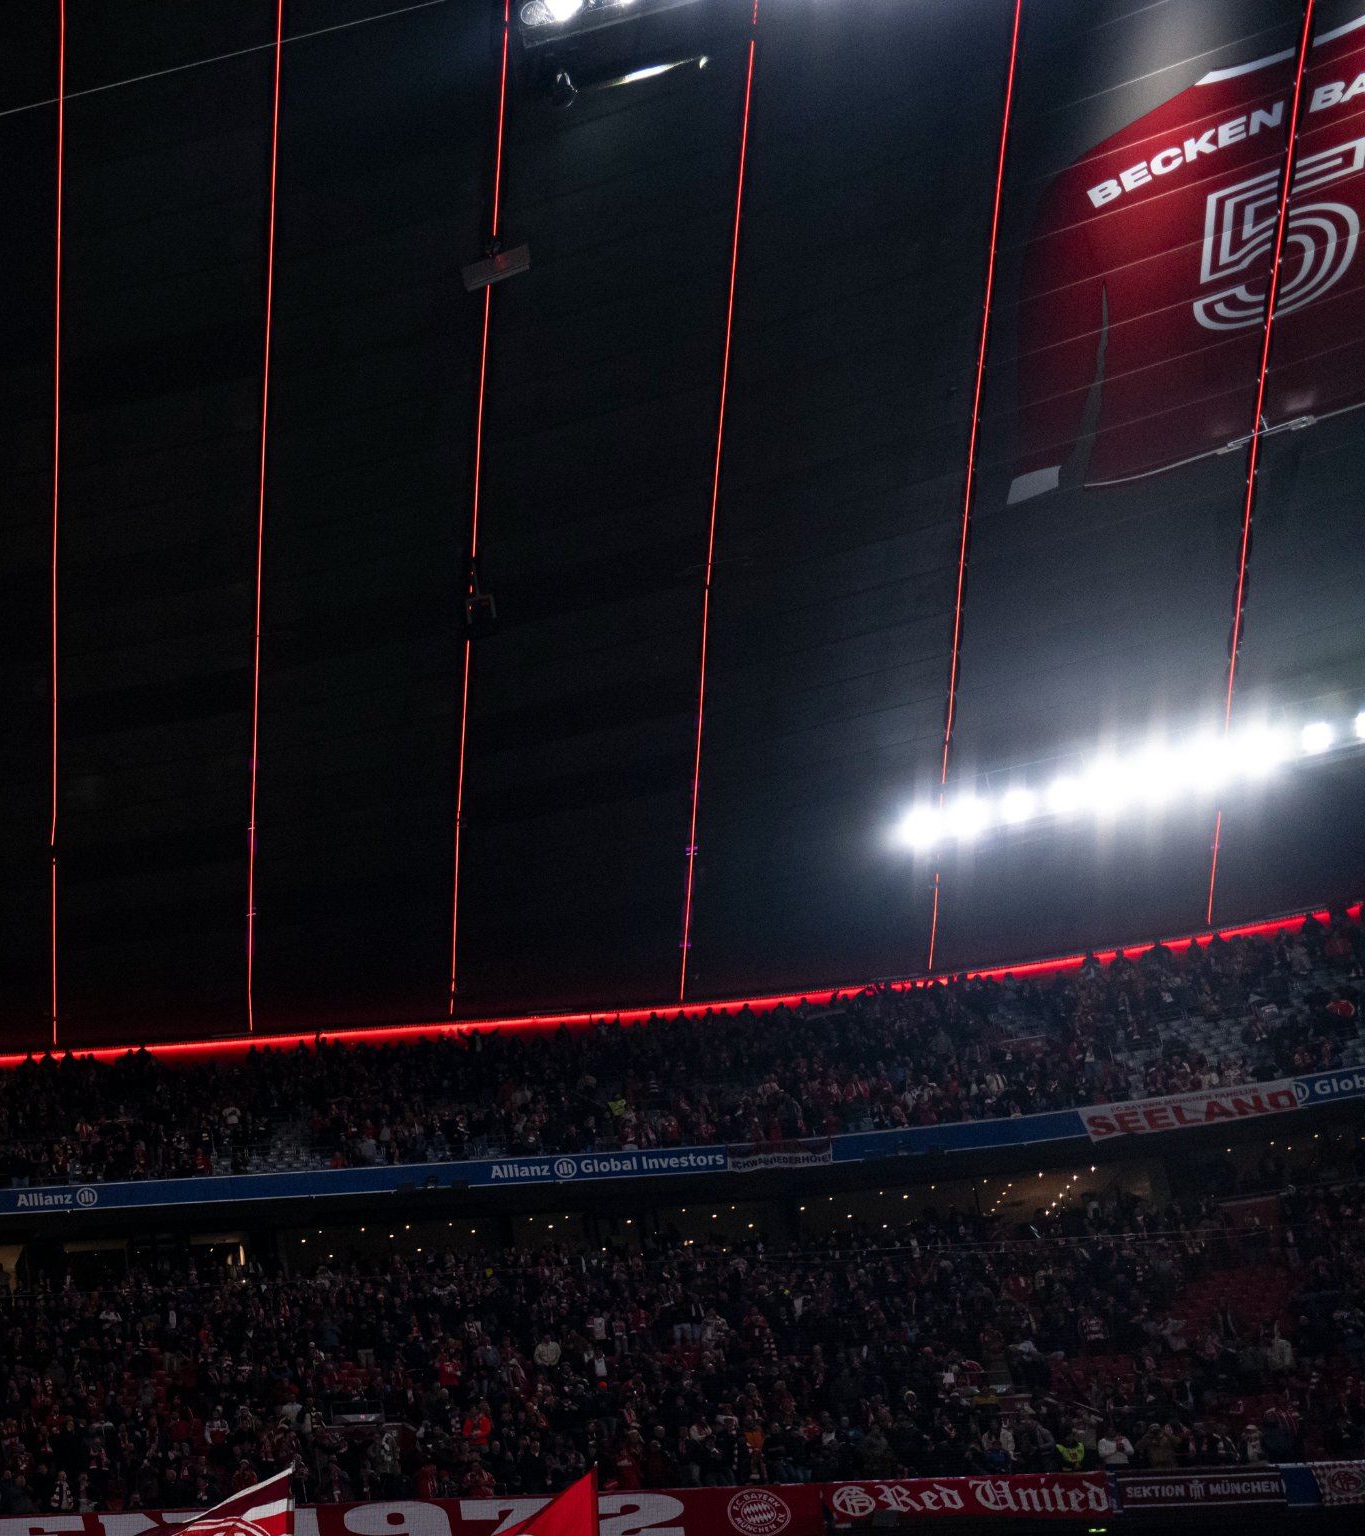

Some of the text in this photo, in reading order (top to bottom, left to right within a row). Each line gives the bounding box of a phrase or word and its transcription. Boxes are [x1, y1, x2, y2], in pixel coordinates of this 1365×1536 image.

[1086, 1090, 1298, 1136] SEELAND
[490, 1162, 551, 1180] Allianz
[580, 1155, 636, 1174] Global
[641, 1152, 725, 1171] Investors
[17, 1191, 72, 1208] Allianz
[877, 1479, 1109, 1513] Red United
[1126, 1479, 1279, 1499] SEKTION MÜNCHEN
